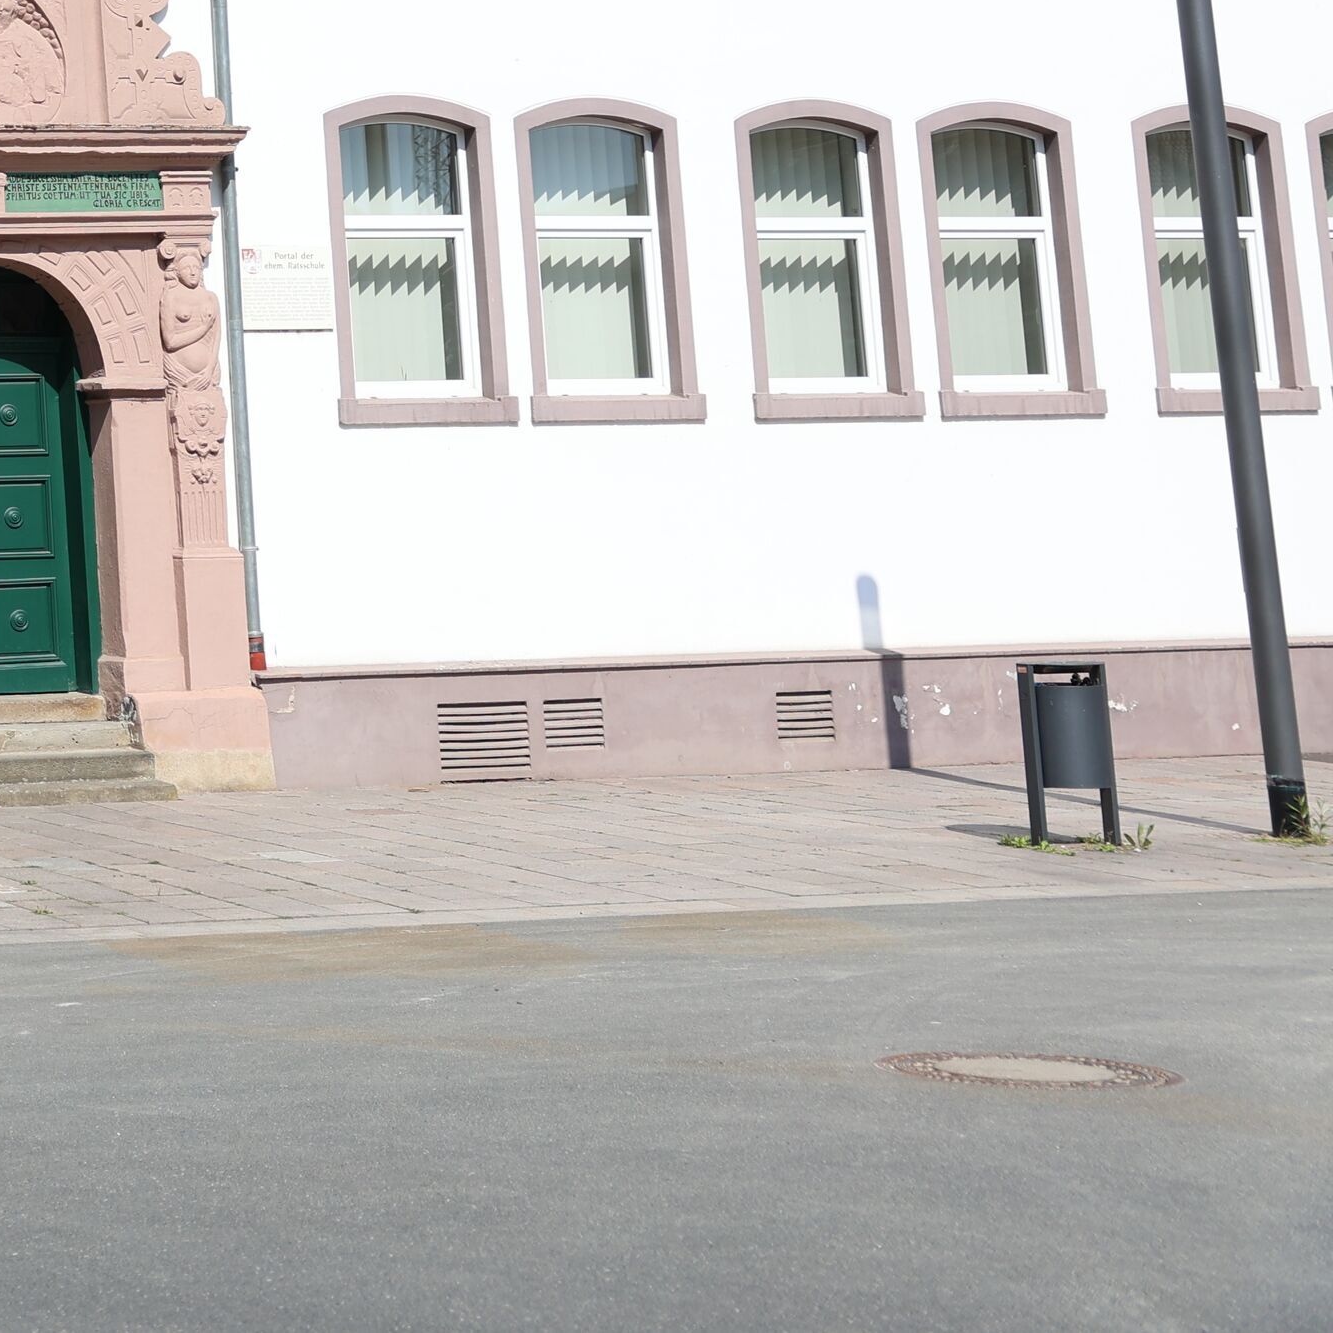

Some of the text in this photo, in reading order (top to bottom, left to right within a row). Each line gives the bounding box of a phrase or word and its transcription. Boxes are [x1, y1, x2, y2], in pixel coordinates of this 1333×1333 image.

[5, 183, 41, 192] CHRISTE
[93, 199, 124, 208] GLORIA
[274, 251, 314, 260] Portal der
